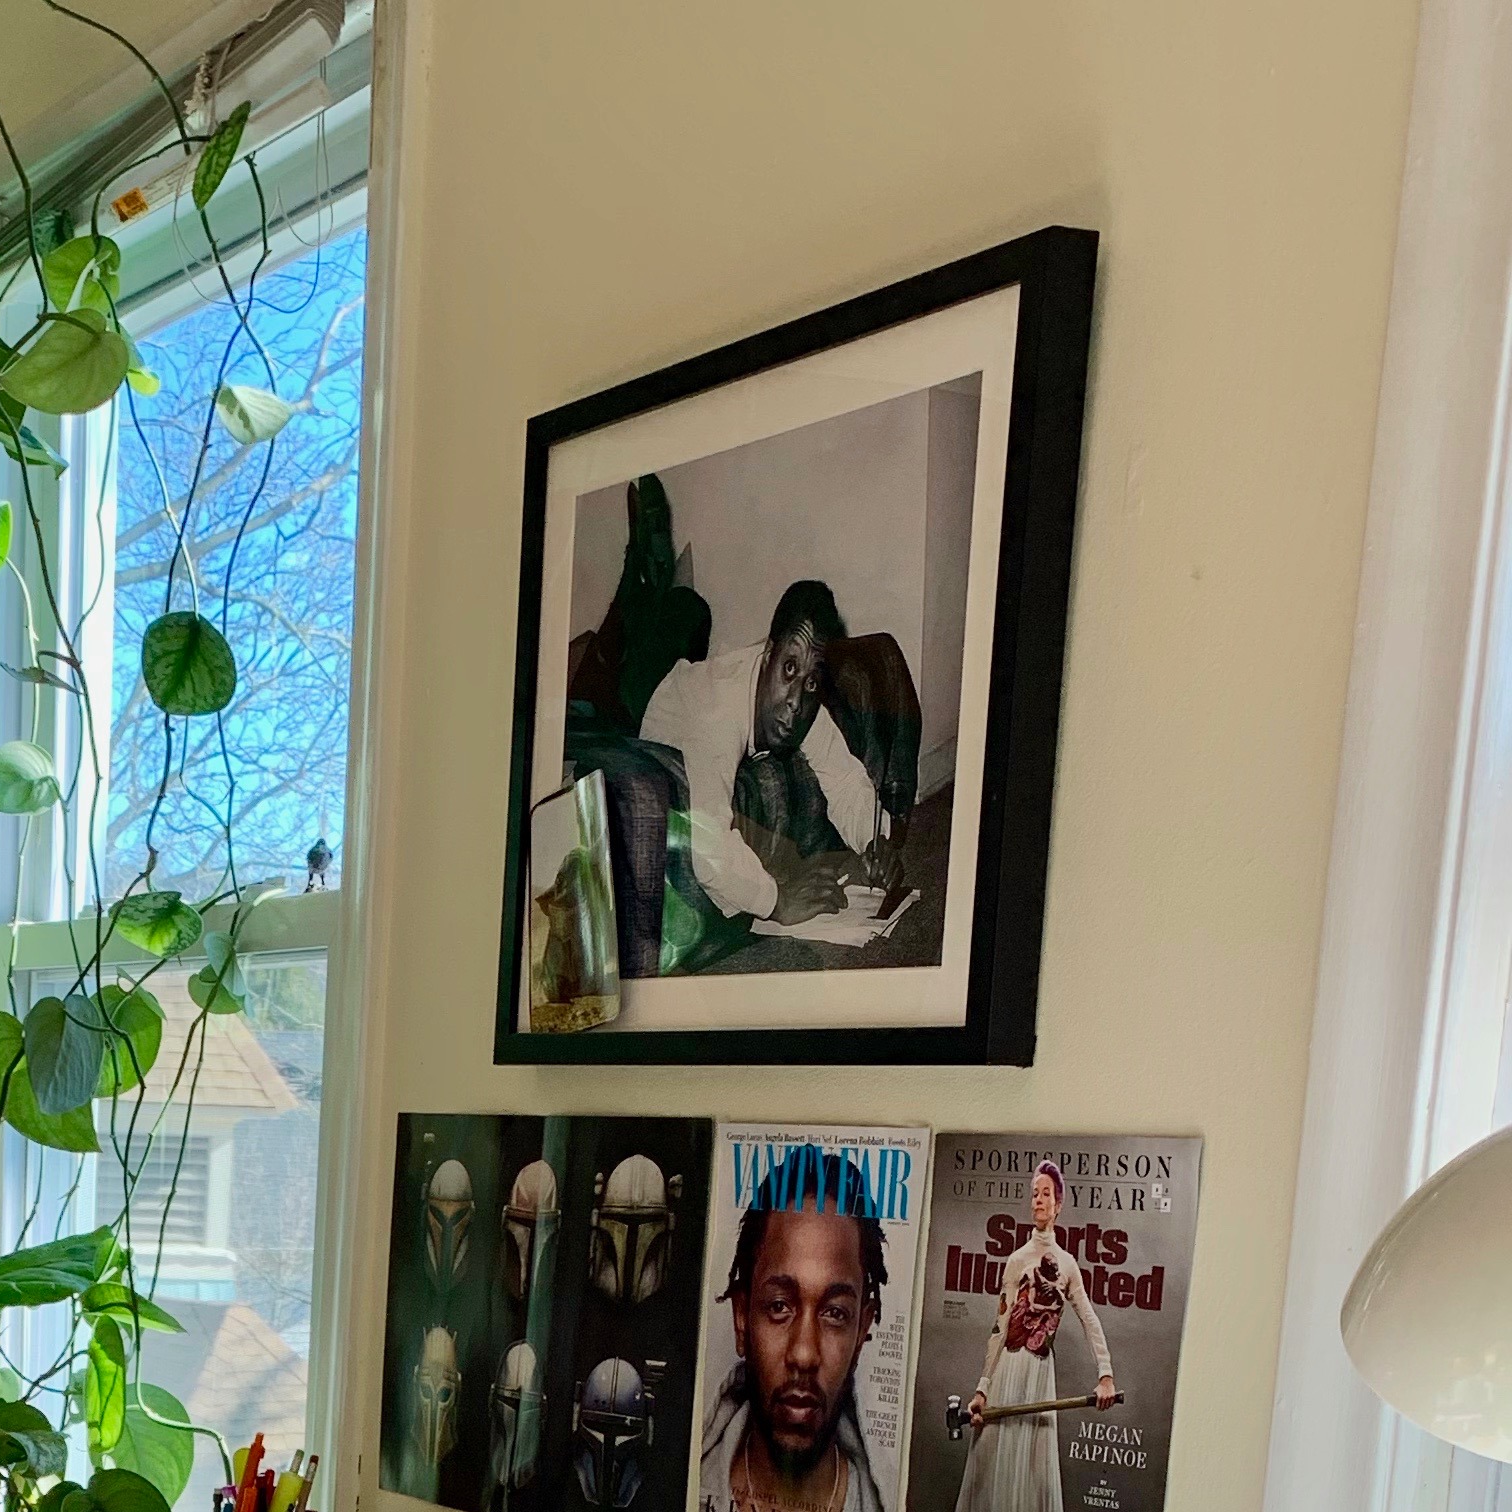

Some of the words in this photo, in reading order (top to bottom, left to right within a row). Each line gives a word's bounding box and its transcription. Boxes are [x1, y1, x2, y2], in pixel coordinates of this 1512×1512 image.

[733, 1142, 835, 1215] VANITY
[835, 1147, 912, 1221] FAIR
[953, 1179, 978, 1197] OF
[985, 1181, 1024, 1199] THE
[1069, 1185, 1146, 1212] YEAR
[944, 1245, 1165, 1311] Illuted
[1078, 1421, 1143, 1446] MEGAN
[1069, 1441, 1148, 1470] RAPINOE
[1088, 1486, 1117, 1499] JENNY
